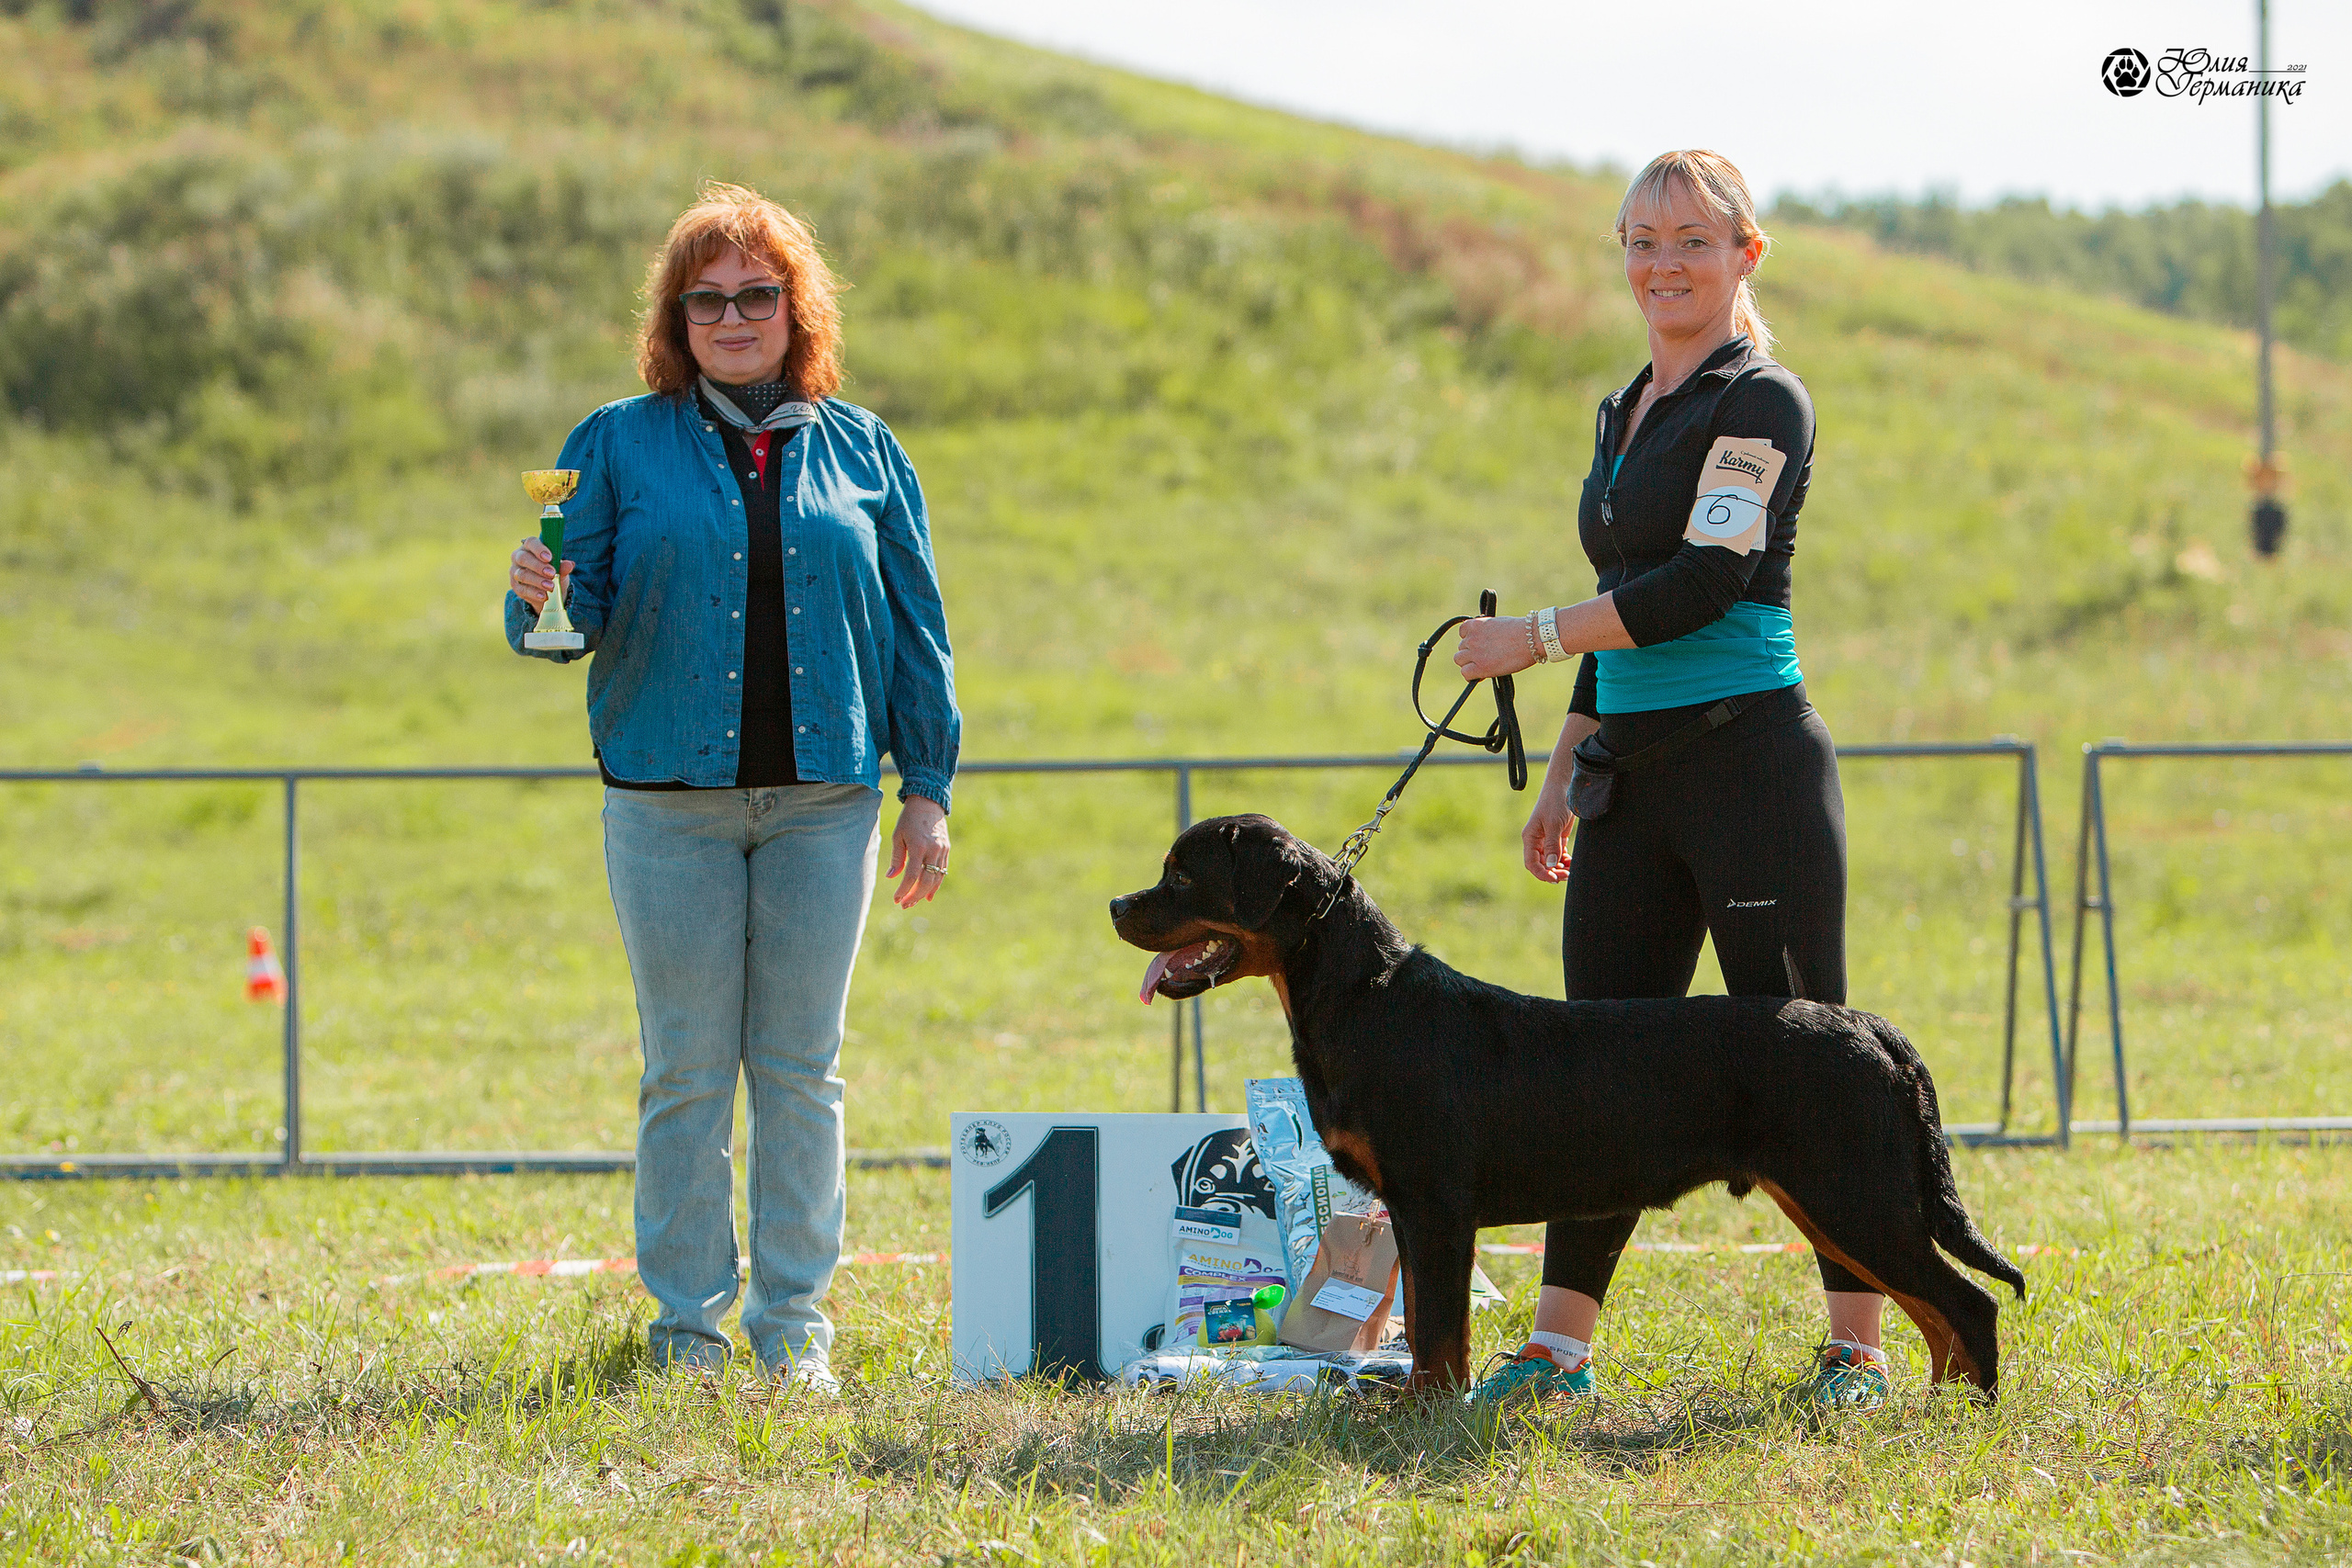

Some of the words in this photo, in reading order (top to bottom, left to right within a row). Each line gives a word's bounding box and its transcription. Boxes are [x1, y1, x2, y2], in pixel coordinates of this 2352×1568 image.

[1718, 449, 1766, 479] Karmy
[1706, 493, 1738, 525] 6
[1736, 898, 1778, 908] DEMIX
[983, 1125, 1114, 1381] 1
[1183, 1268, 1247, 1282] COMPLEX
[1549, 1345, 1578, 1359] SPORT
